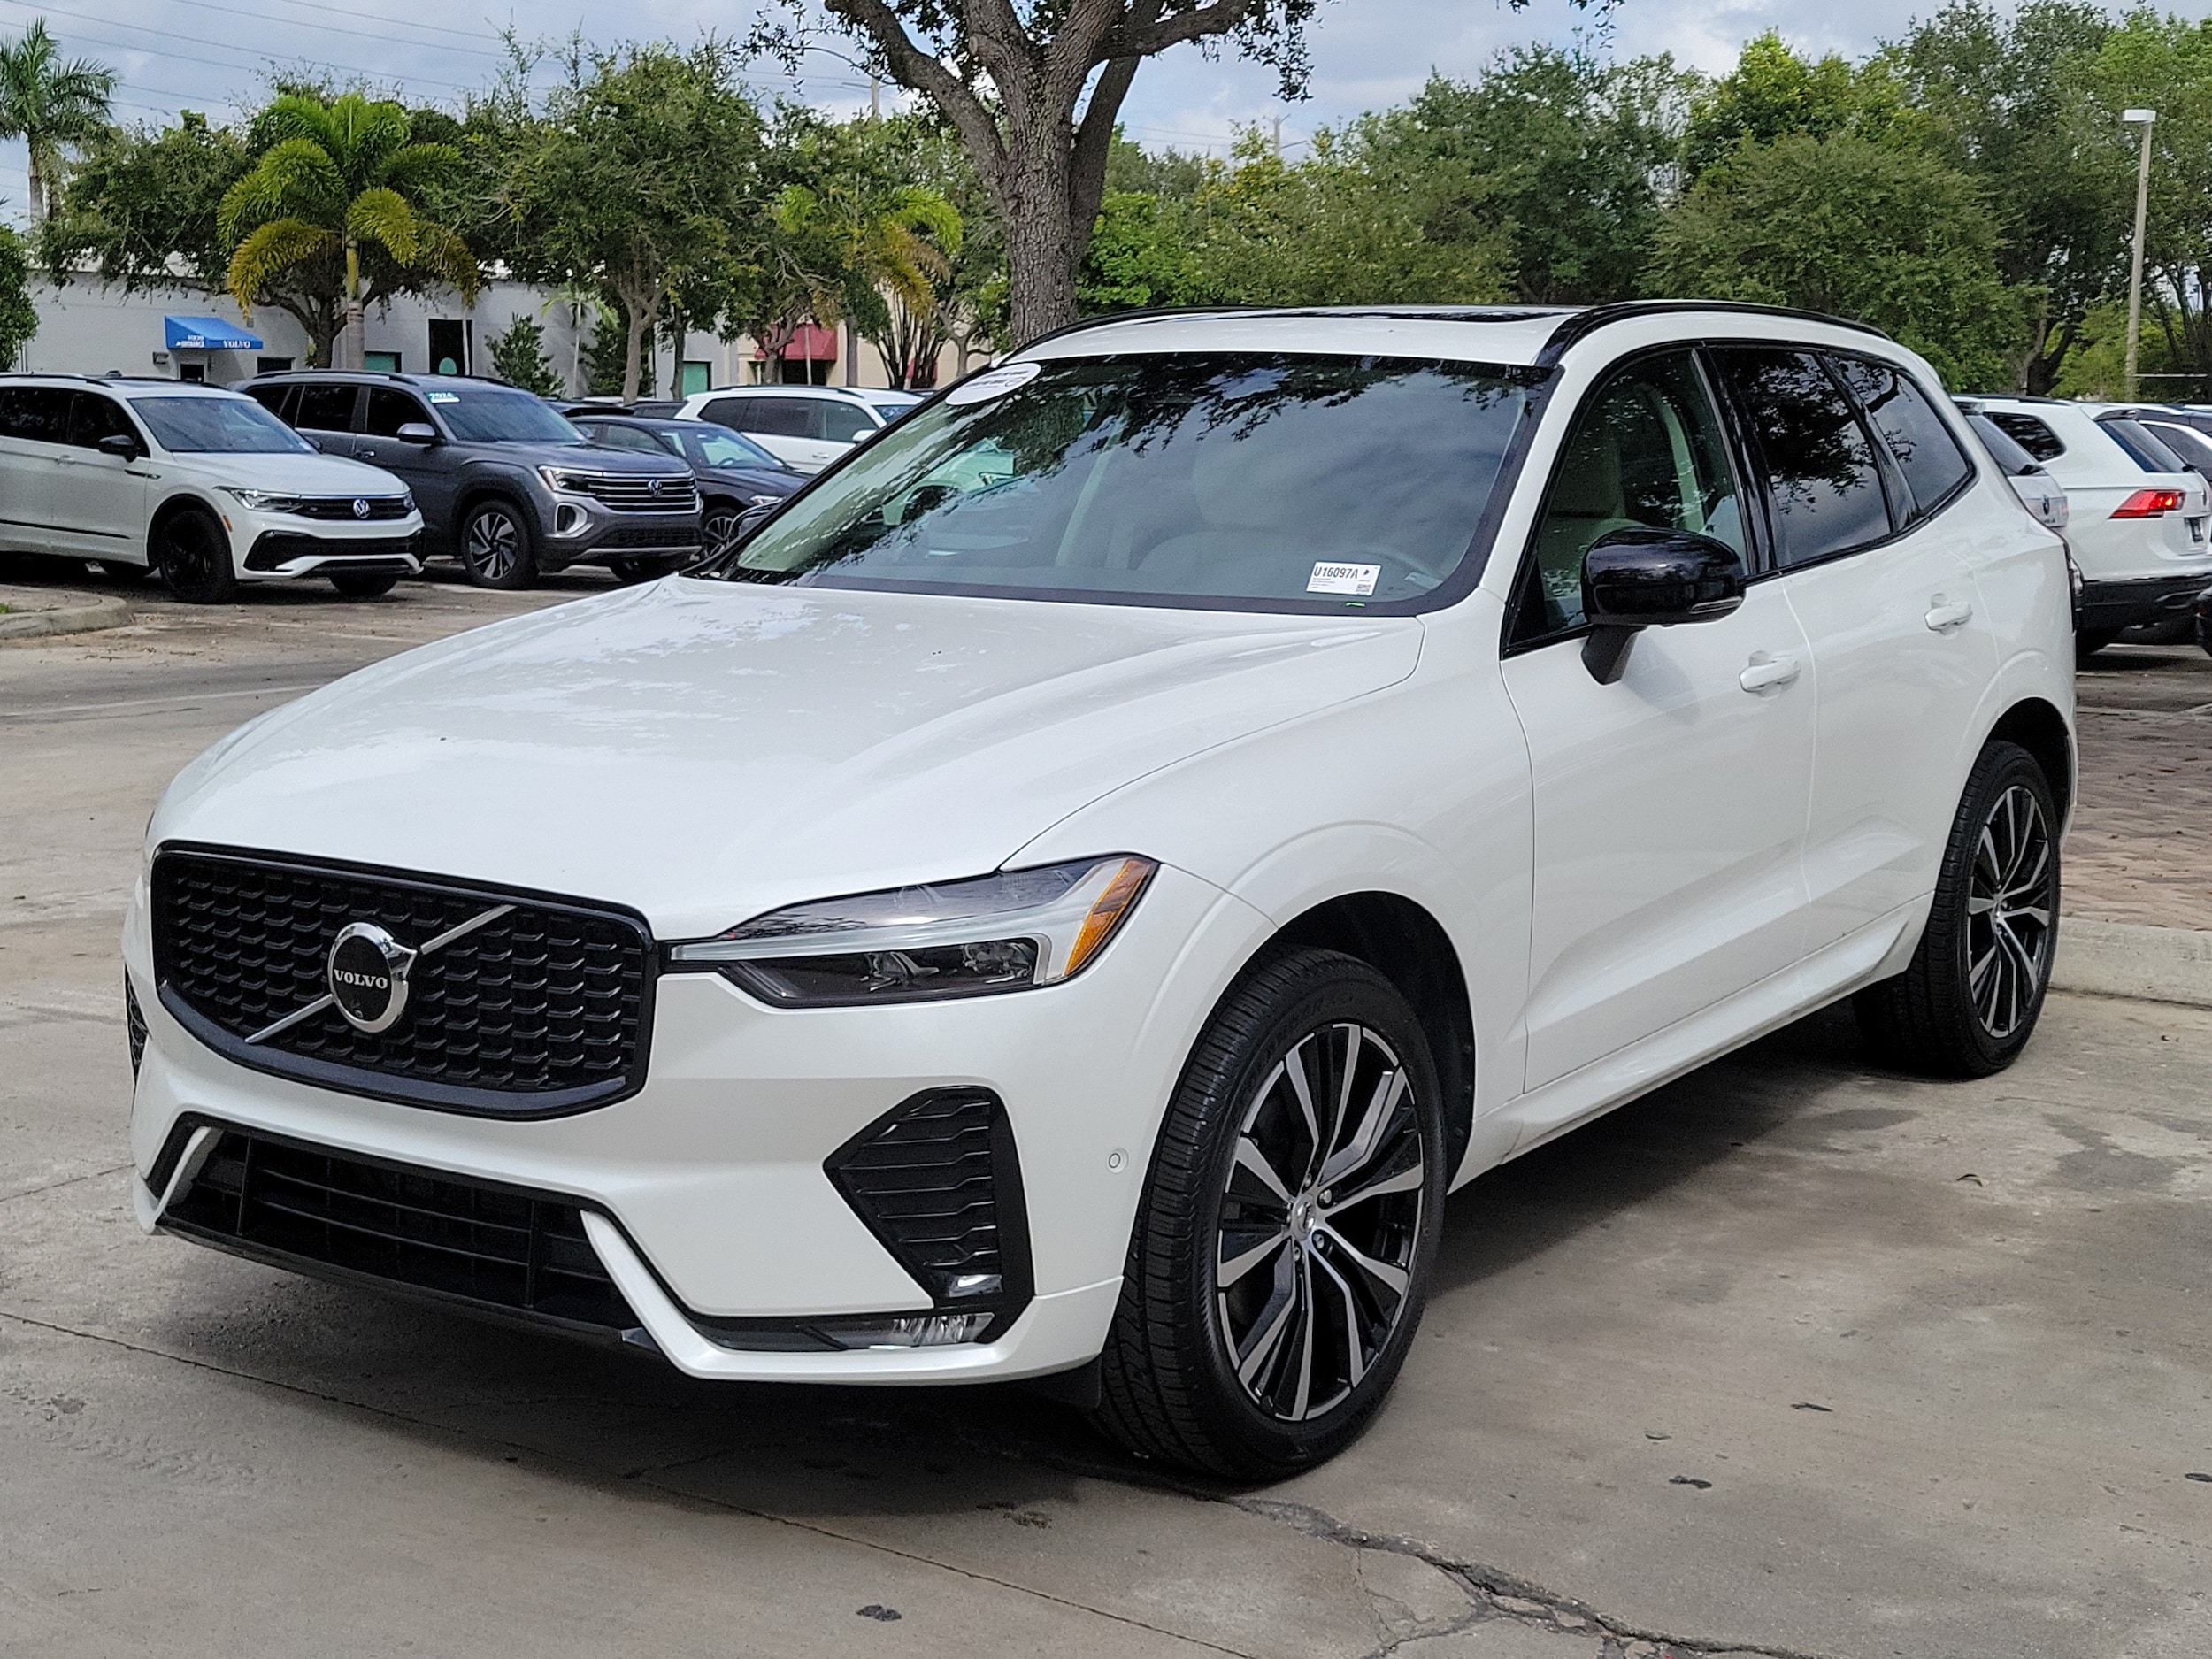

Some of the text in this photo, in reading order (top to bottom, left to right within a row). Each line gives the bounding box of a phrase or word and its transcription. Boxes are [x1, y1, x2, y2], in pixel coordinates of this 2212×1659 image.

[223, 340, 250, 349] VOLVO
[1314, 566, 1358, 579] U16097A
[334, 969, 388, 988] VOLVO
